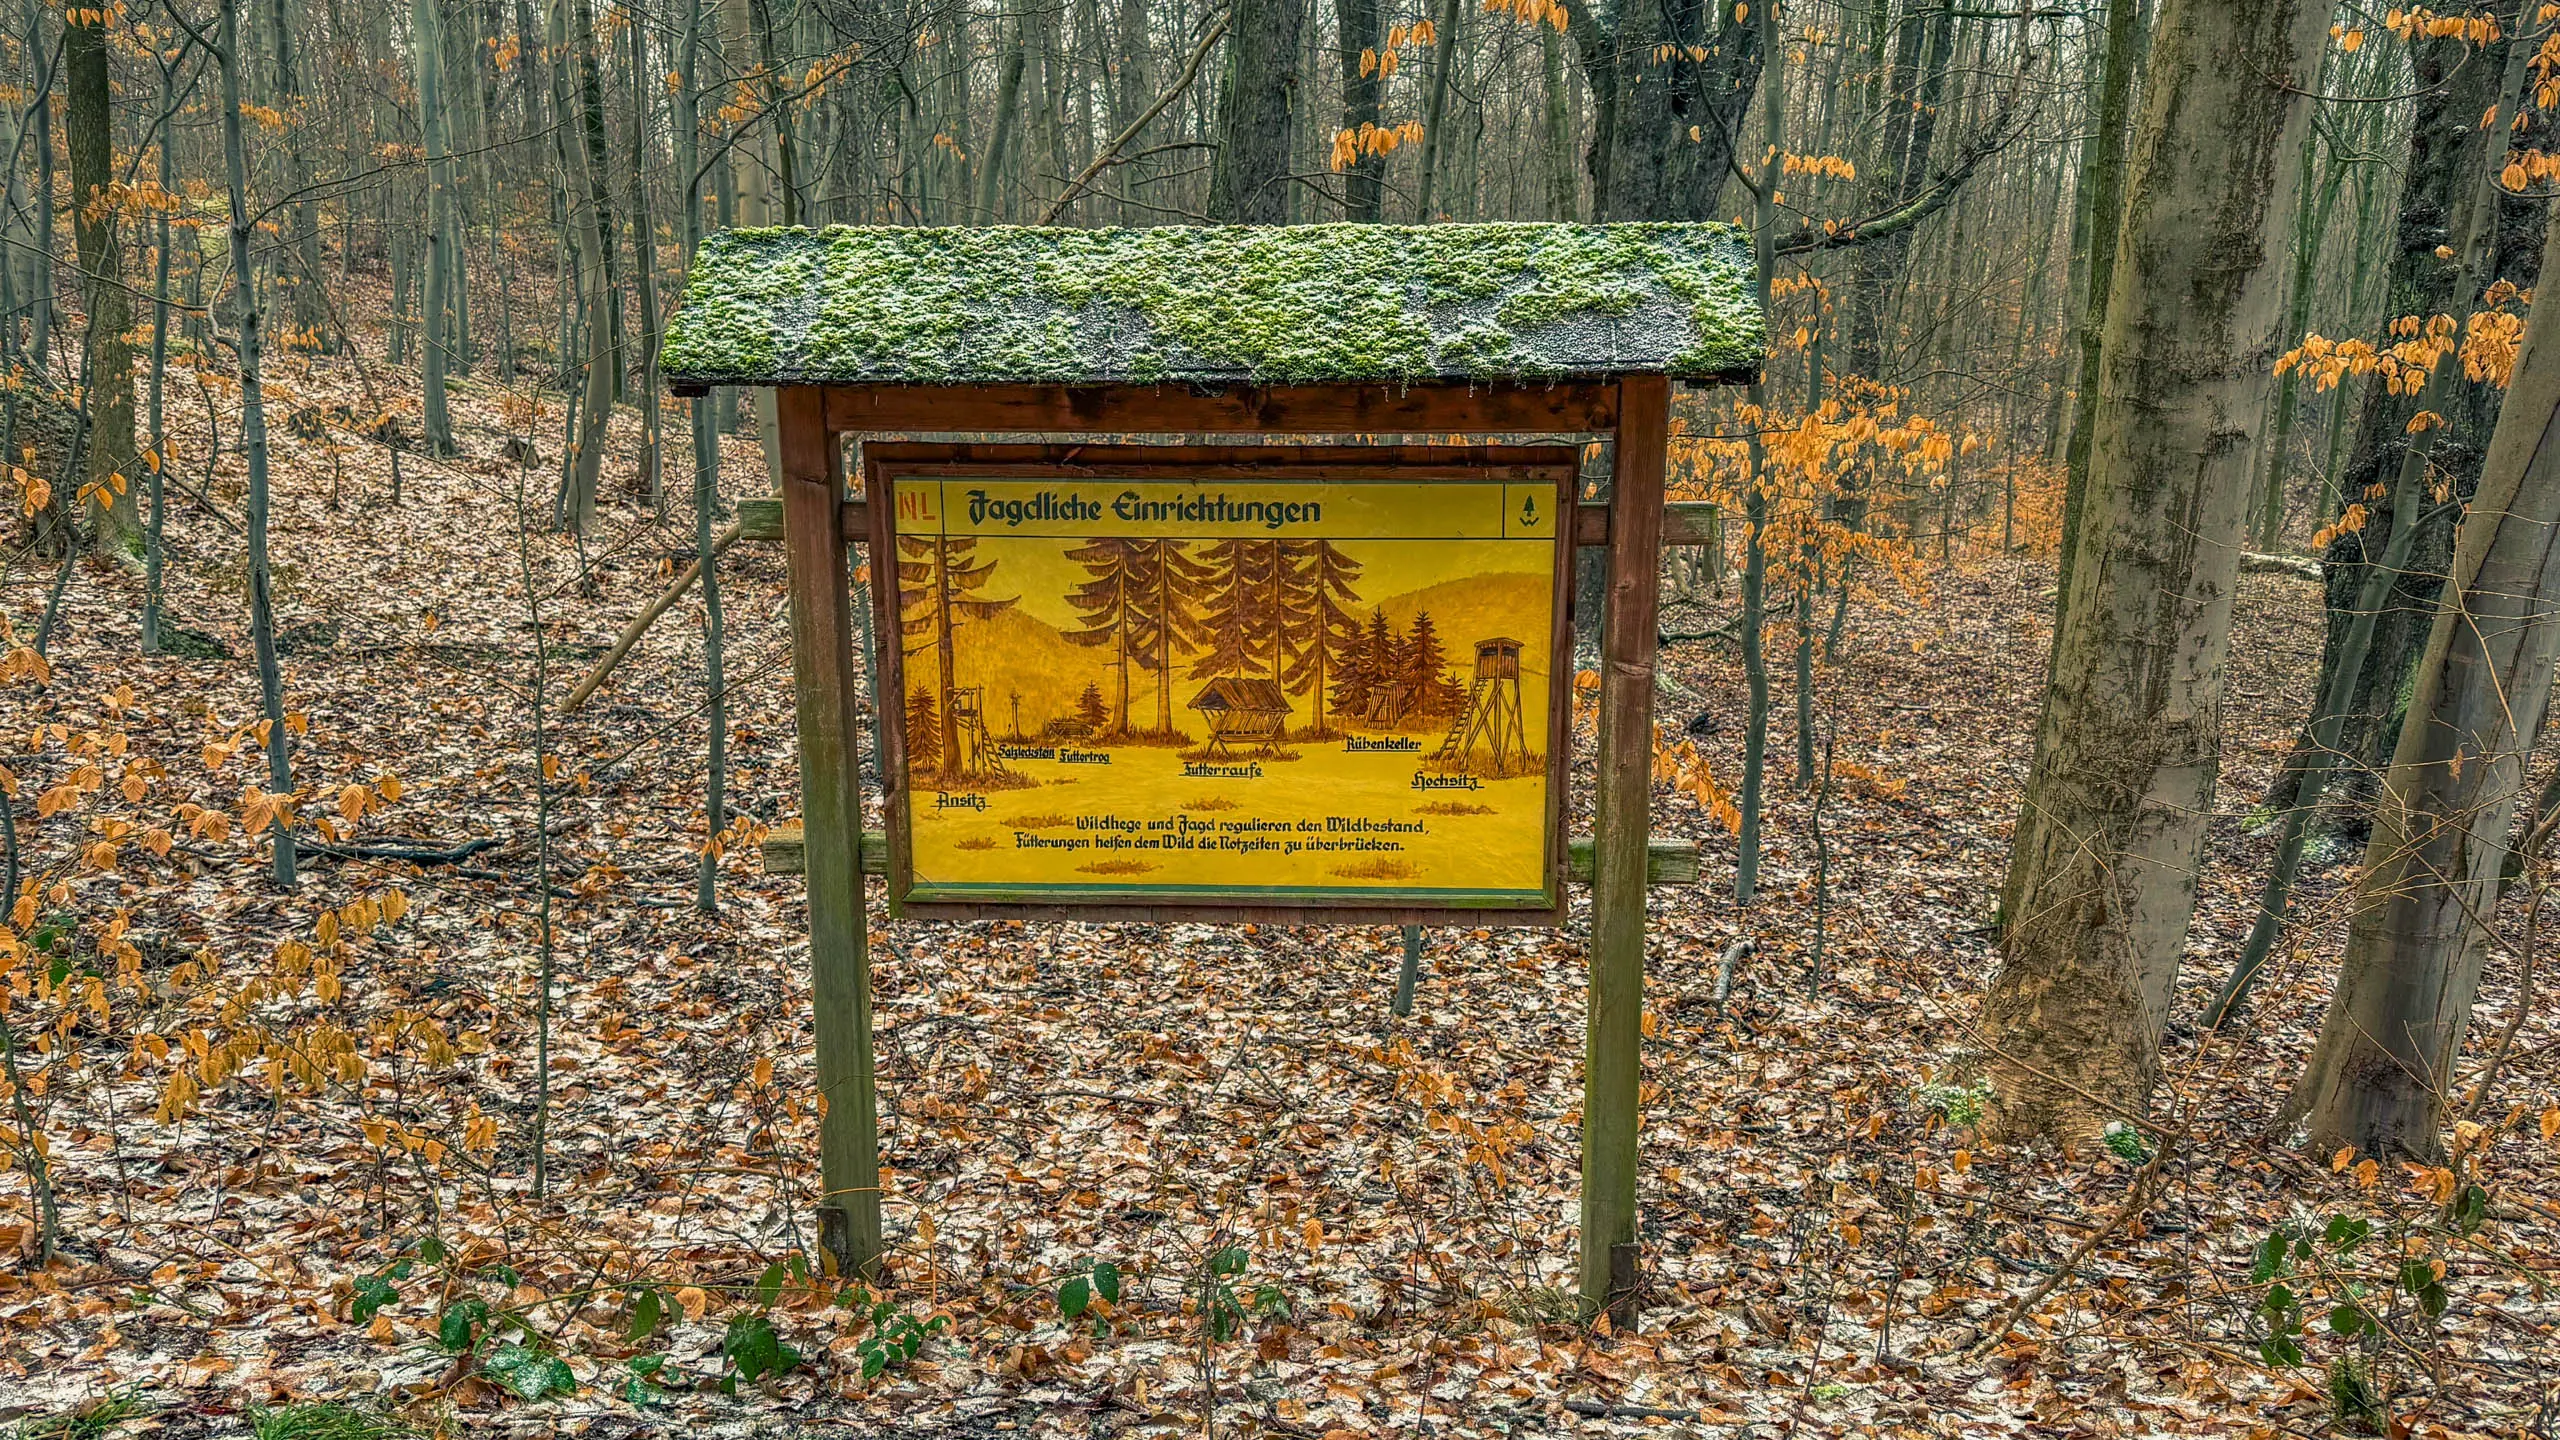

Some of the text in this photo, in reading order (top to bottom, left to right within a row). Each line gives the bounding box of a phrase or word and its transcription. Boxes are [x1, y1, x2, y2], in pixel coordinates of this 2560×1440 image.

[899, 492, 936, 521] NL
[968, 490, 1322, 529] Jagdliche Einrichtungen
[1346, 736, 1422, 752] Rübenkeller
[1183, 760, 1264, 777] Futterraufe
[1411, 772, 1480, 790] Hochsitz
[936, 791, 986, 812] Ansitz
[1076, 814, 1430, 836] Wildhege und Jagd regulieren den Wildbestand,
[1014, 831, 1406, 855] Fütterungen helfen dem Wild die Notzeiten zu überbrücken.
